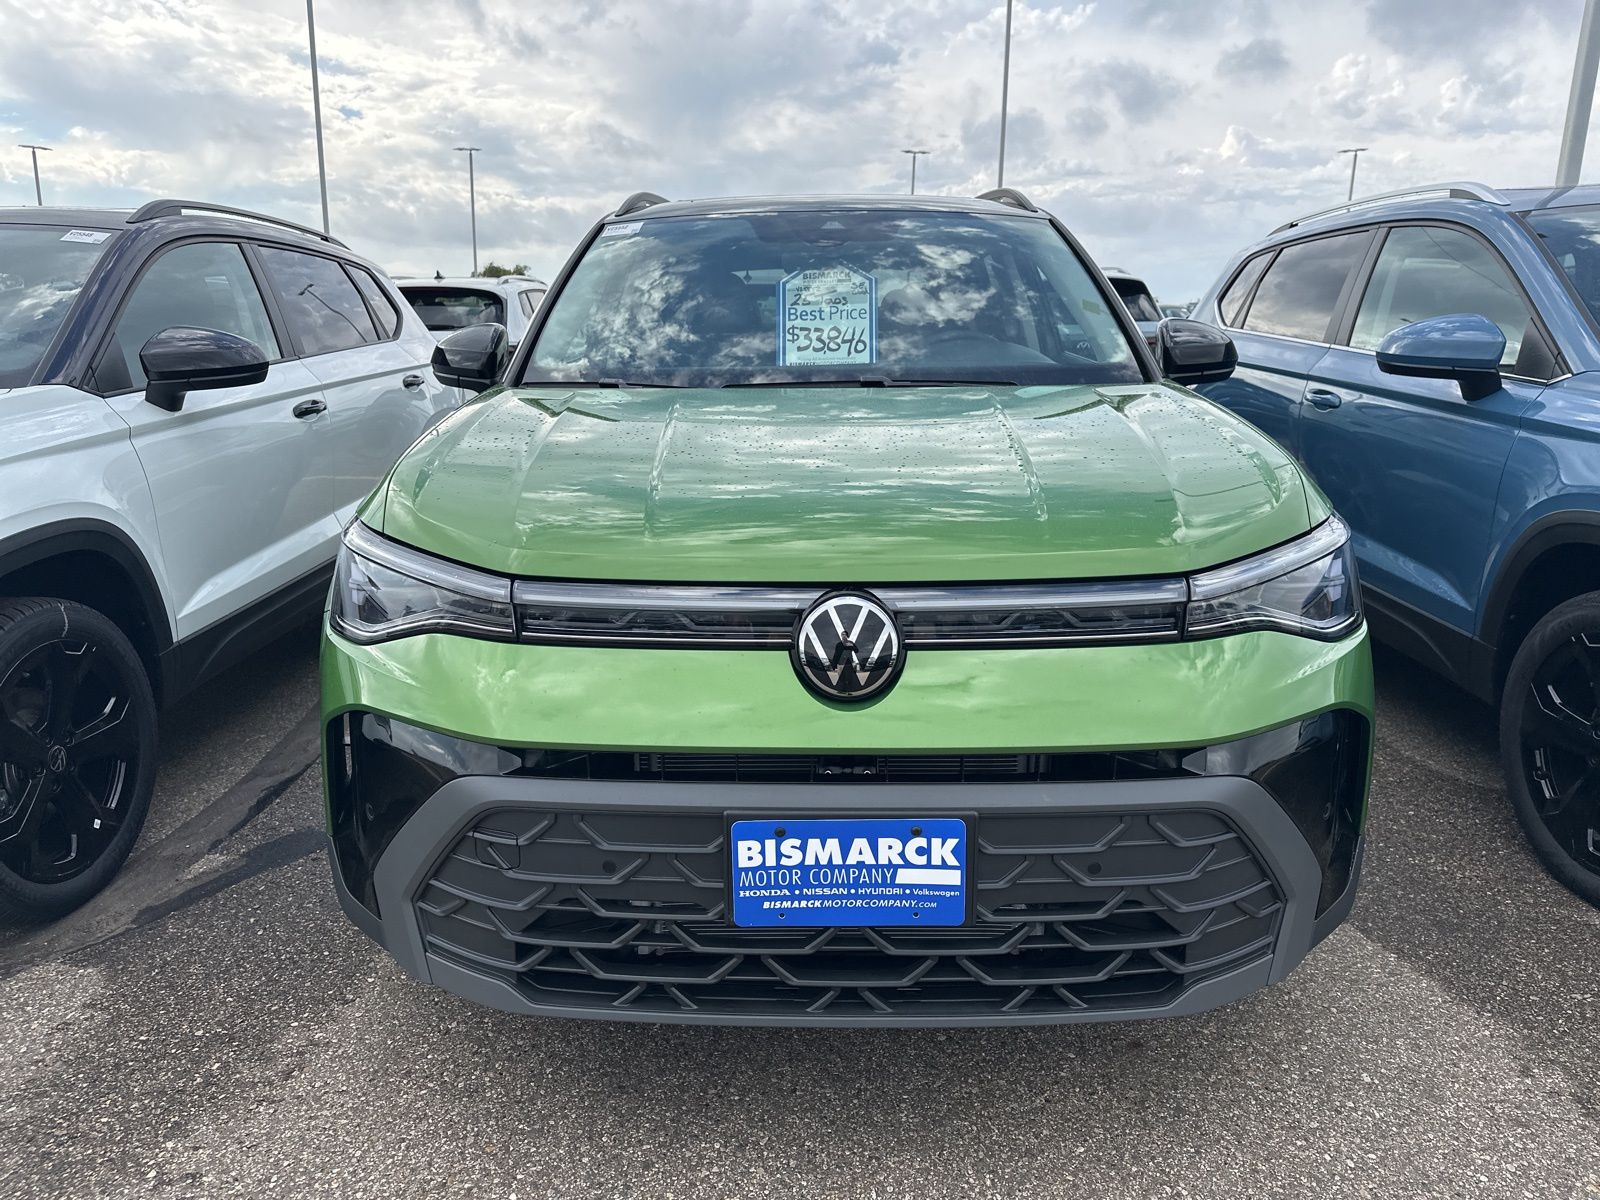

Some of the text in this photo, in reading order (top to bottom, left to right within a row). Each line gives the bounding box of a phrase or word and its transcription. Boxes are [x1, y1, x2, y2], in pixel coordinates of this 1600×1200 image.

[802, 271, 851, 280] BISMARCK
[787, 305, 867, 321] Best Price
[787, 324, 868, 357] $33,846
[737, 837, 960, 868] BISMARCK
[739, 868, 894, 887] MOTOR COMPANY
[739, 889, 792, 897] HONDA
[912, 888, 960, 897] Volkswagen
[763, 899, 937, 909] BISMARCKMOTORCOMPANY.COM
